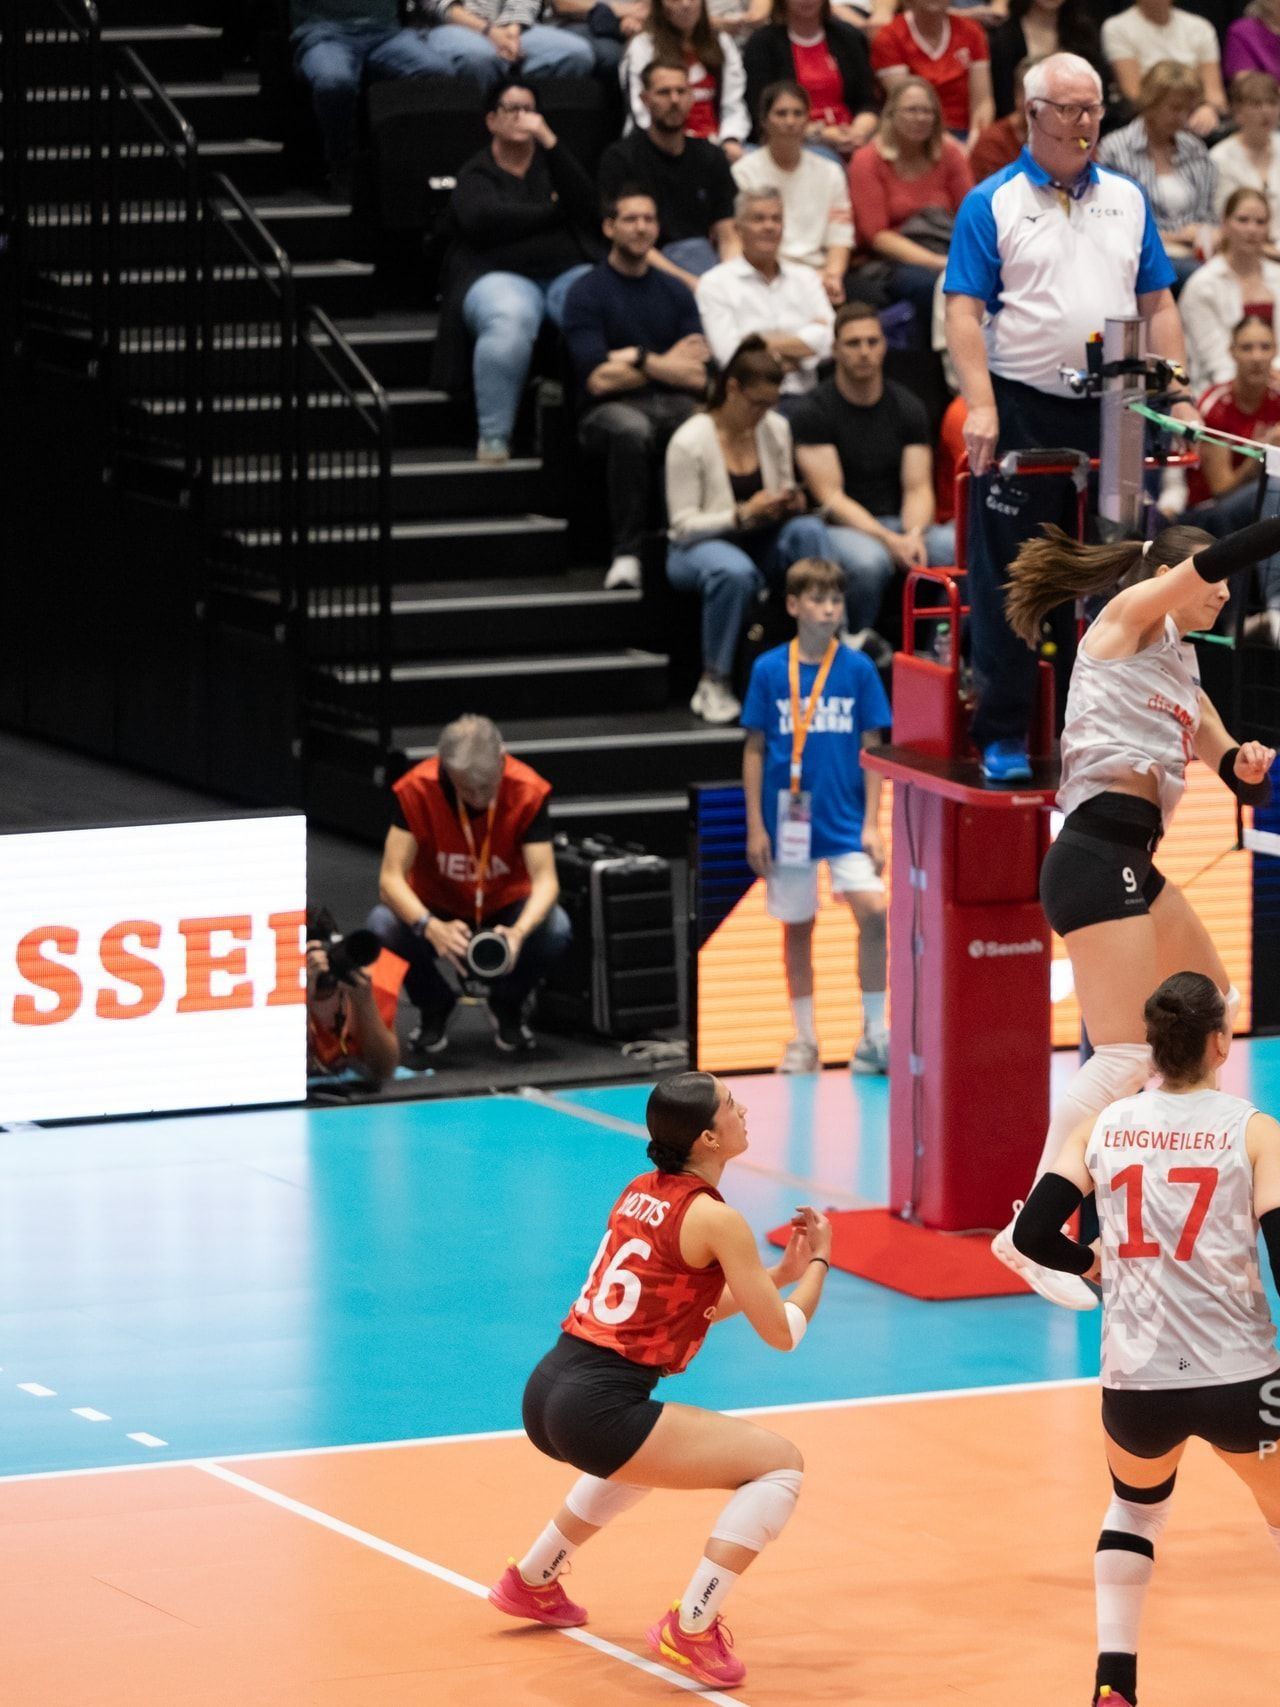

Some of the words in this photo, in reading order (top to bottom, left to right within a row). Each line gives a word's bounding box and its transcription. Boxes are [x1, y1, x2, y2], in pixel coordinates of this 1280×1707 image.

[775, 696, 855, 715] VLEY
[779, 715, 853, 735] LERN
[1121, 866, 1138, 894] 9
[985, 939, 1044, 959] Senoh
[1103, 1129, 1215, 1151] LENGWEILER
[1218, 1131, 1233, 1151] J.
[1109, 1162, 1220, 1263] 17
[573, 1228, 652, 1326] 16
[700, 1576, 720, 1607] CRAFT
